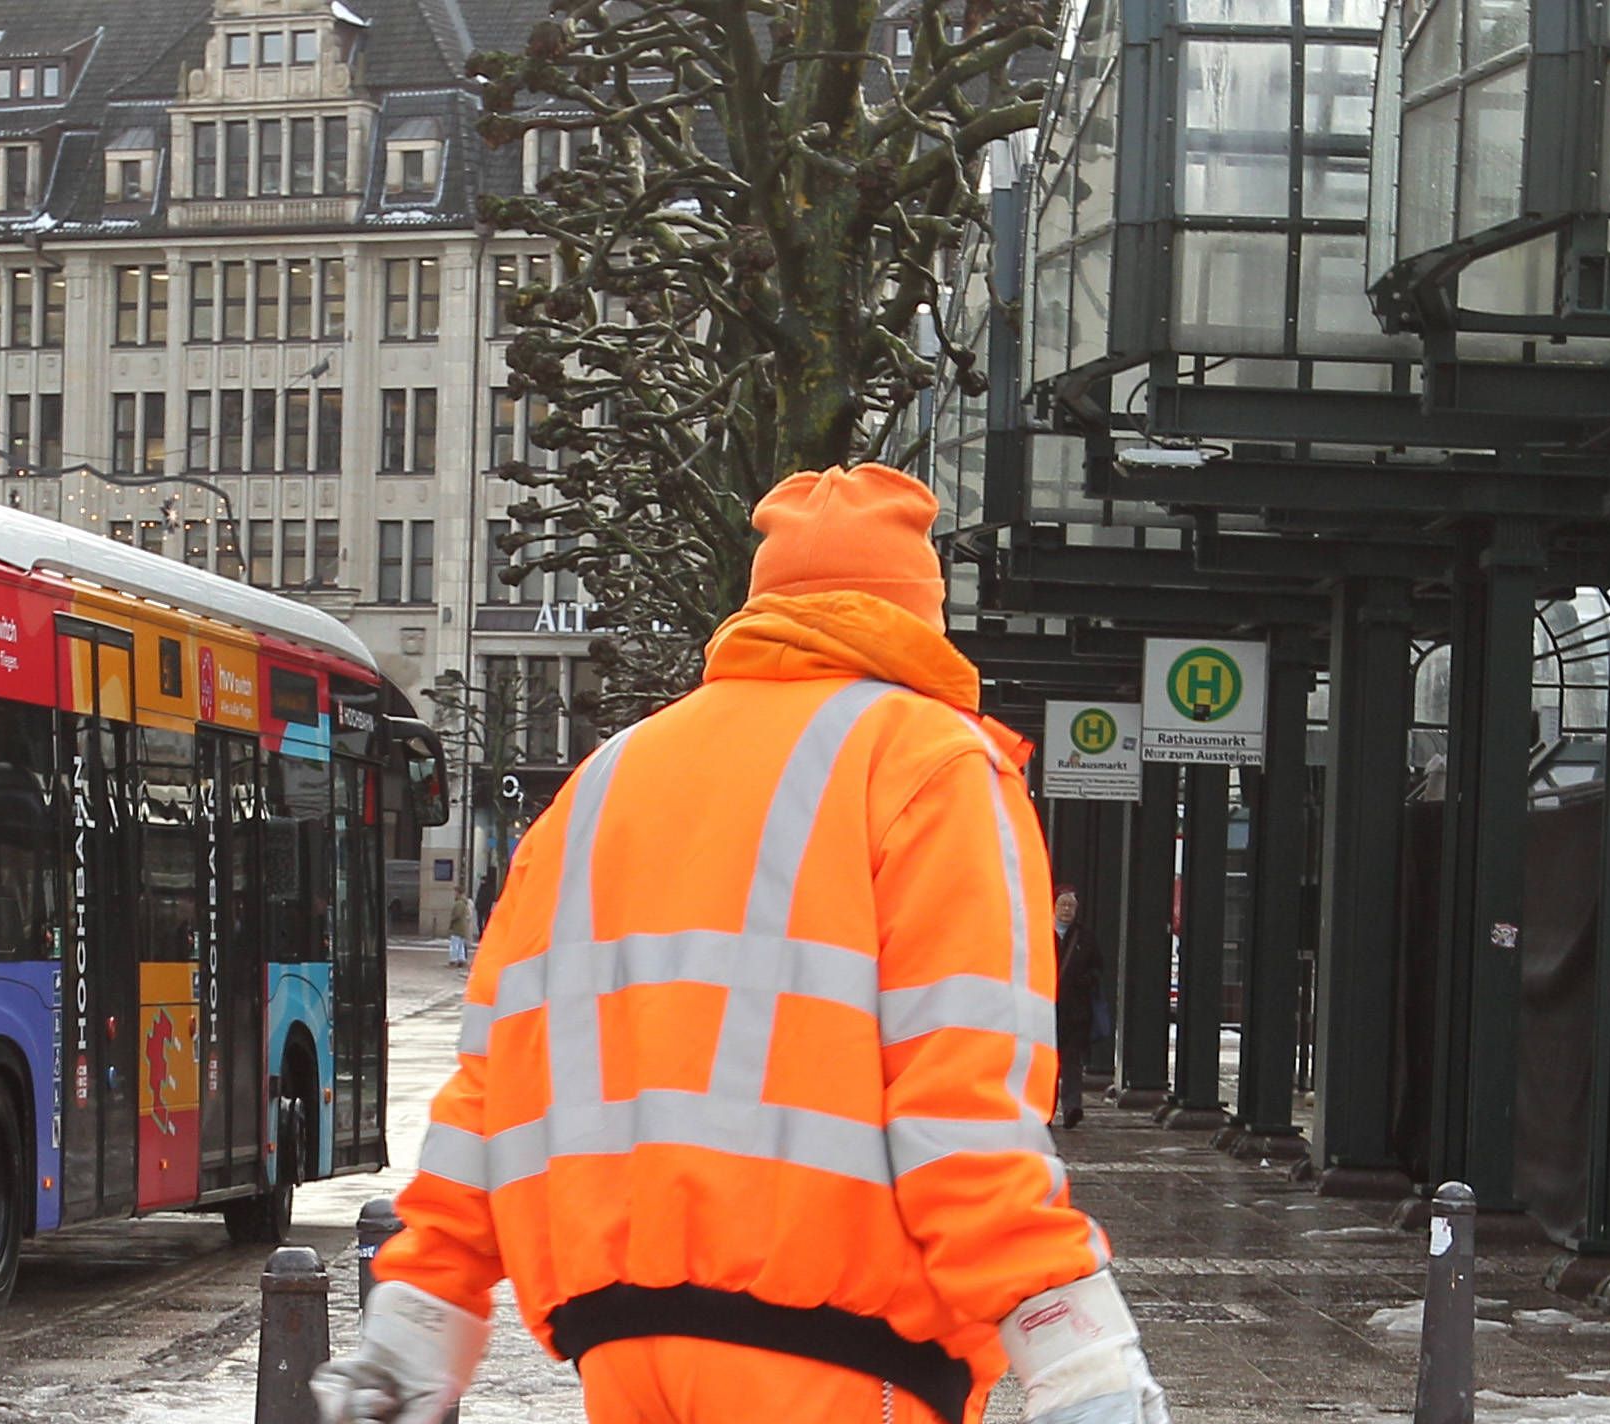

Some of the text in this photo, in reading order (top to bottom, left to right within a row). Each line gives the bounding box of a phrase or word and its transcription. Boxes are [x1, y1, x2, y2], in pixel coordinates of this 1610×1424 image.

[218, 664, 235, 692] hvv
[1187, 665, 1221, 705] H
[1083, 719, 1104, 743] H
[1158, 733, 1246, 746] Rathausmarkt
[1144, 748, 1262, 764] Nur zum Aussteigen
[73, 756, 87, 1049] HOCHBAHN
[208, 778, 217, 1042] HOCHBAHN
